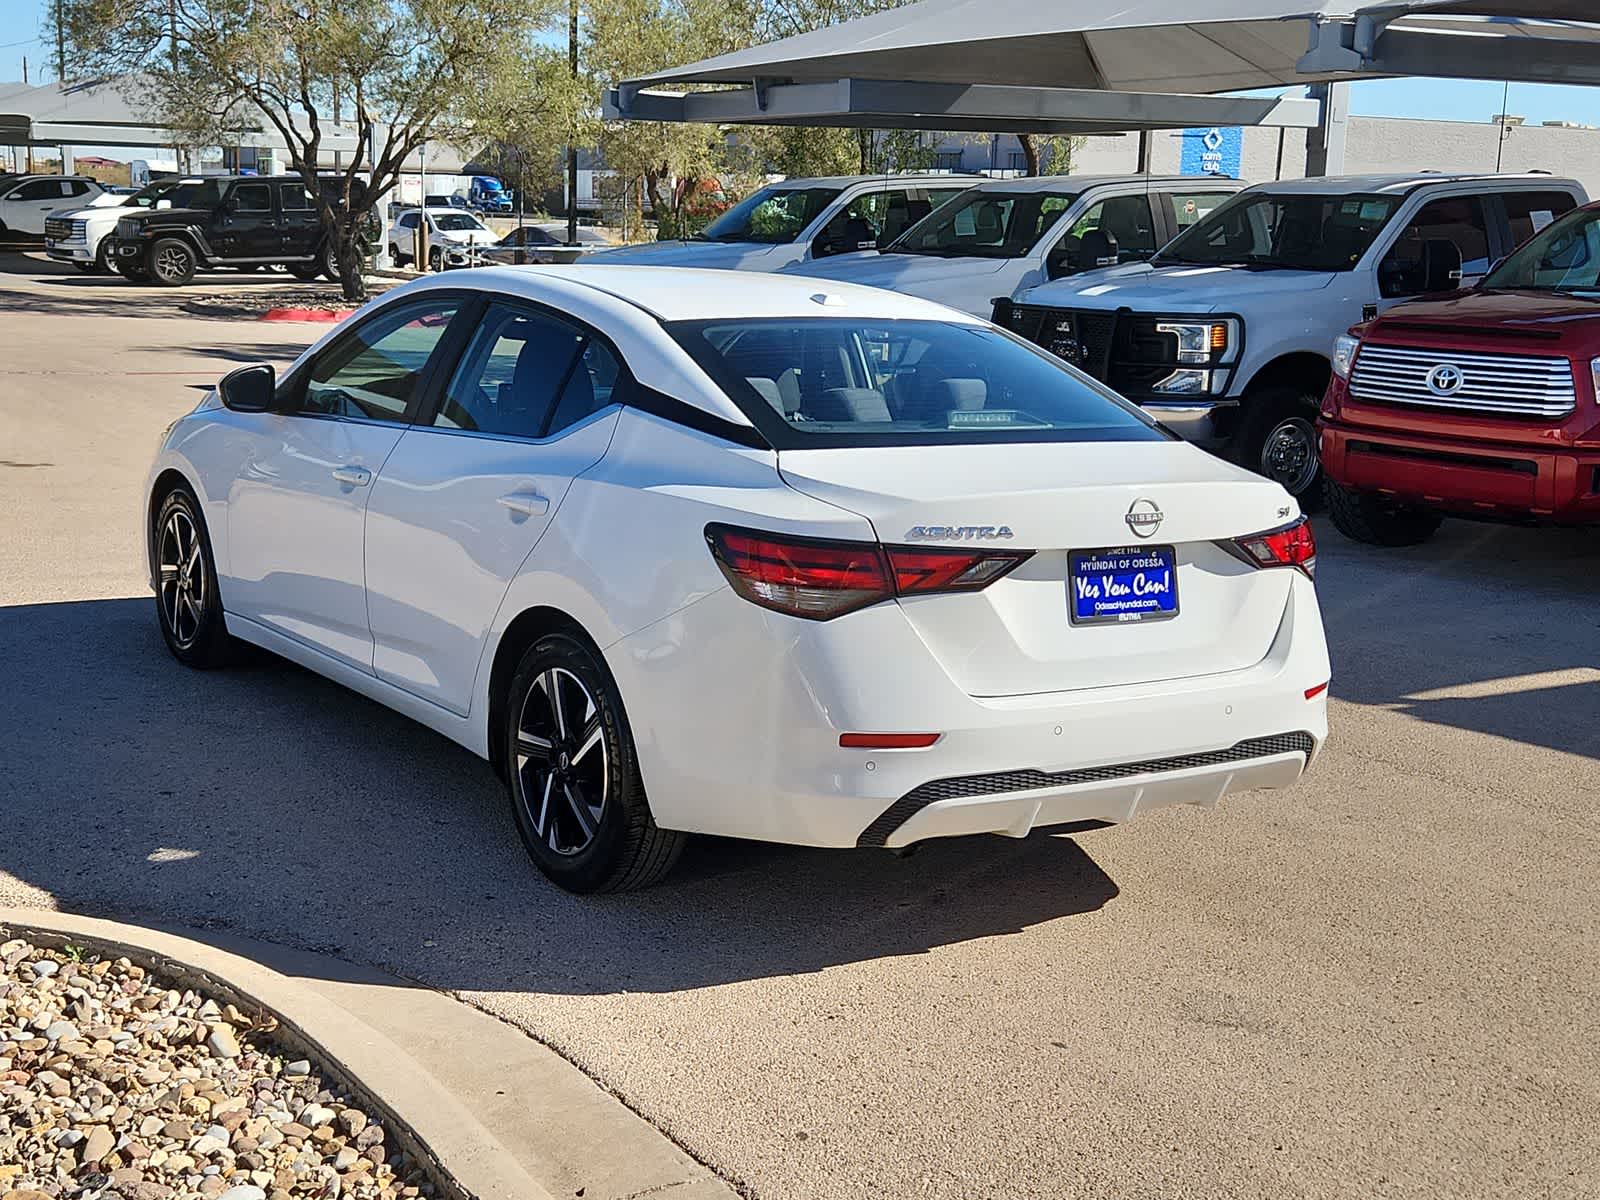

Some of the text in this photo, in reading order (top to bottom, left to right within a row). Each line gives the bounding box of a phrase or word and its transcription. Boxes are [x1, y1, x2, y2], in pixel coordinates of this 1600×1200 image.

[1203, 161, 1220, 171] club
[1081, 558, 1165, 571] HYUNDAI OF ODESSA
[1077, 570, 1169, 599] Yes You Can!
